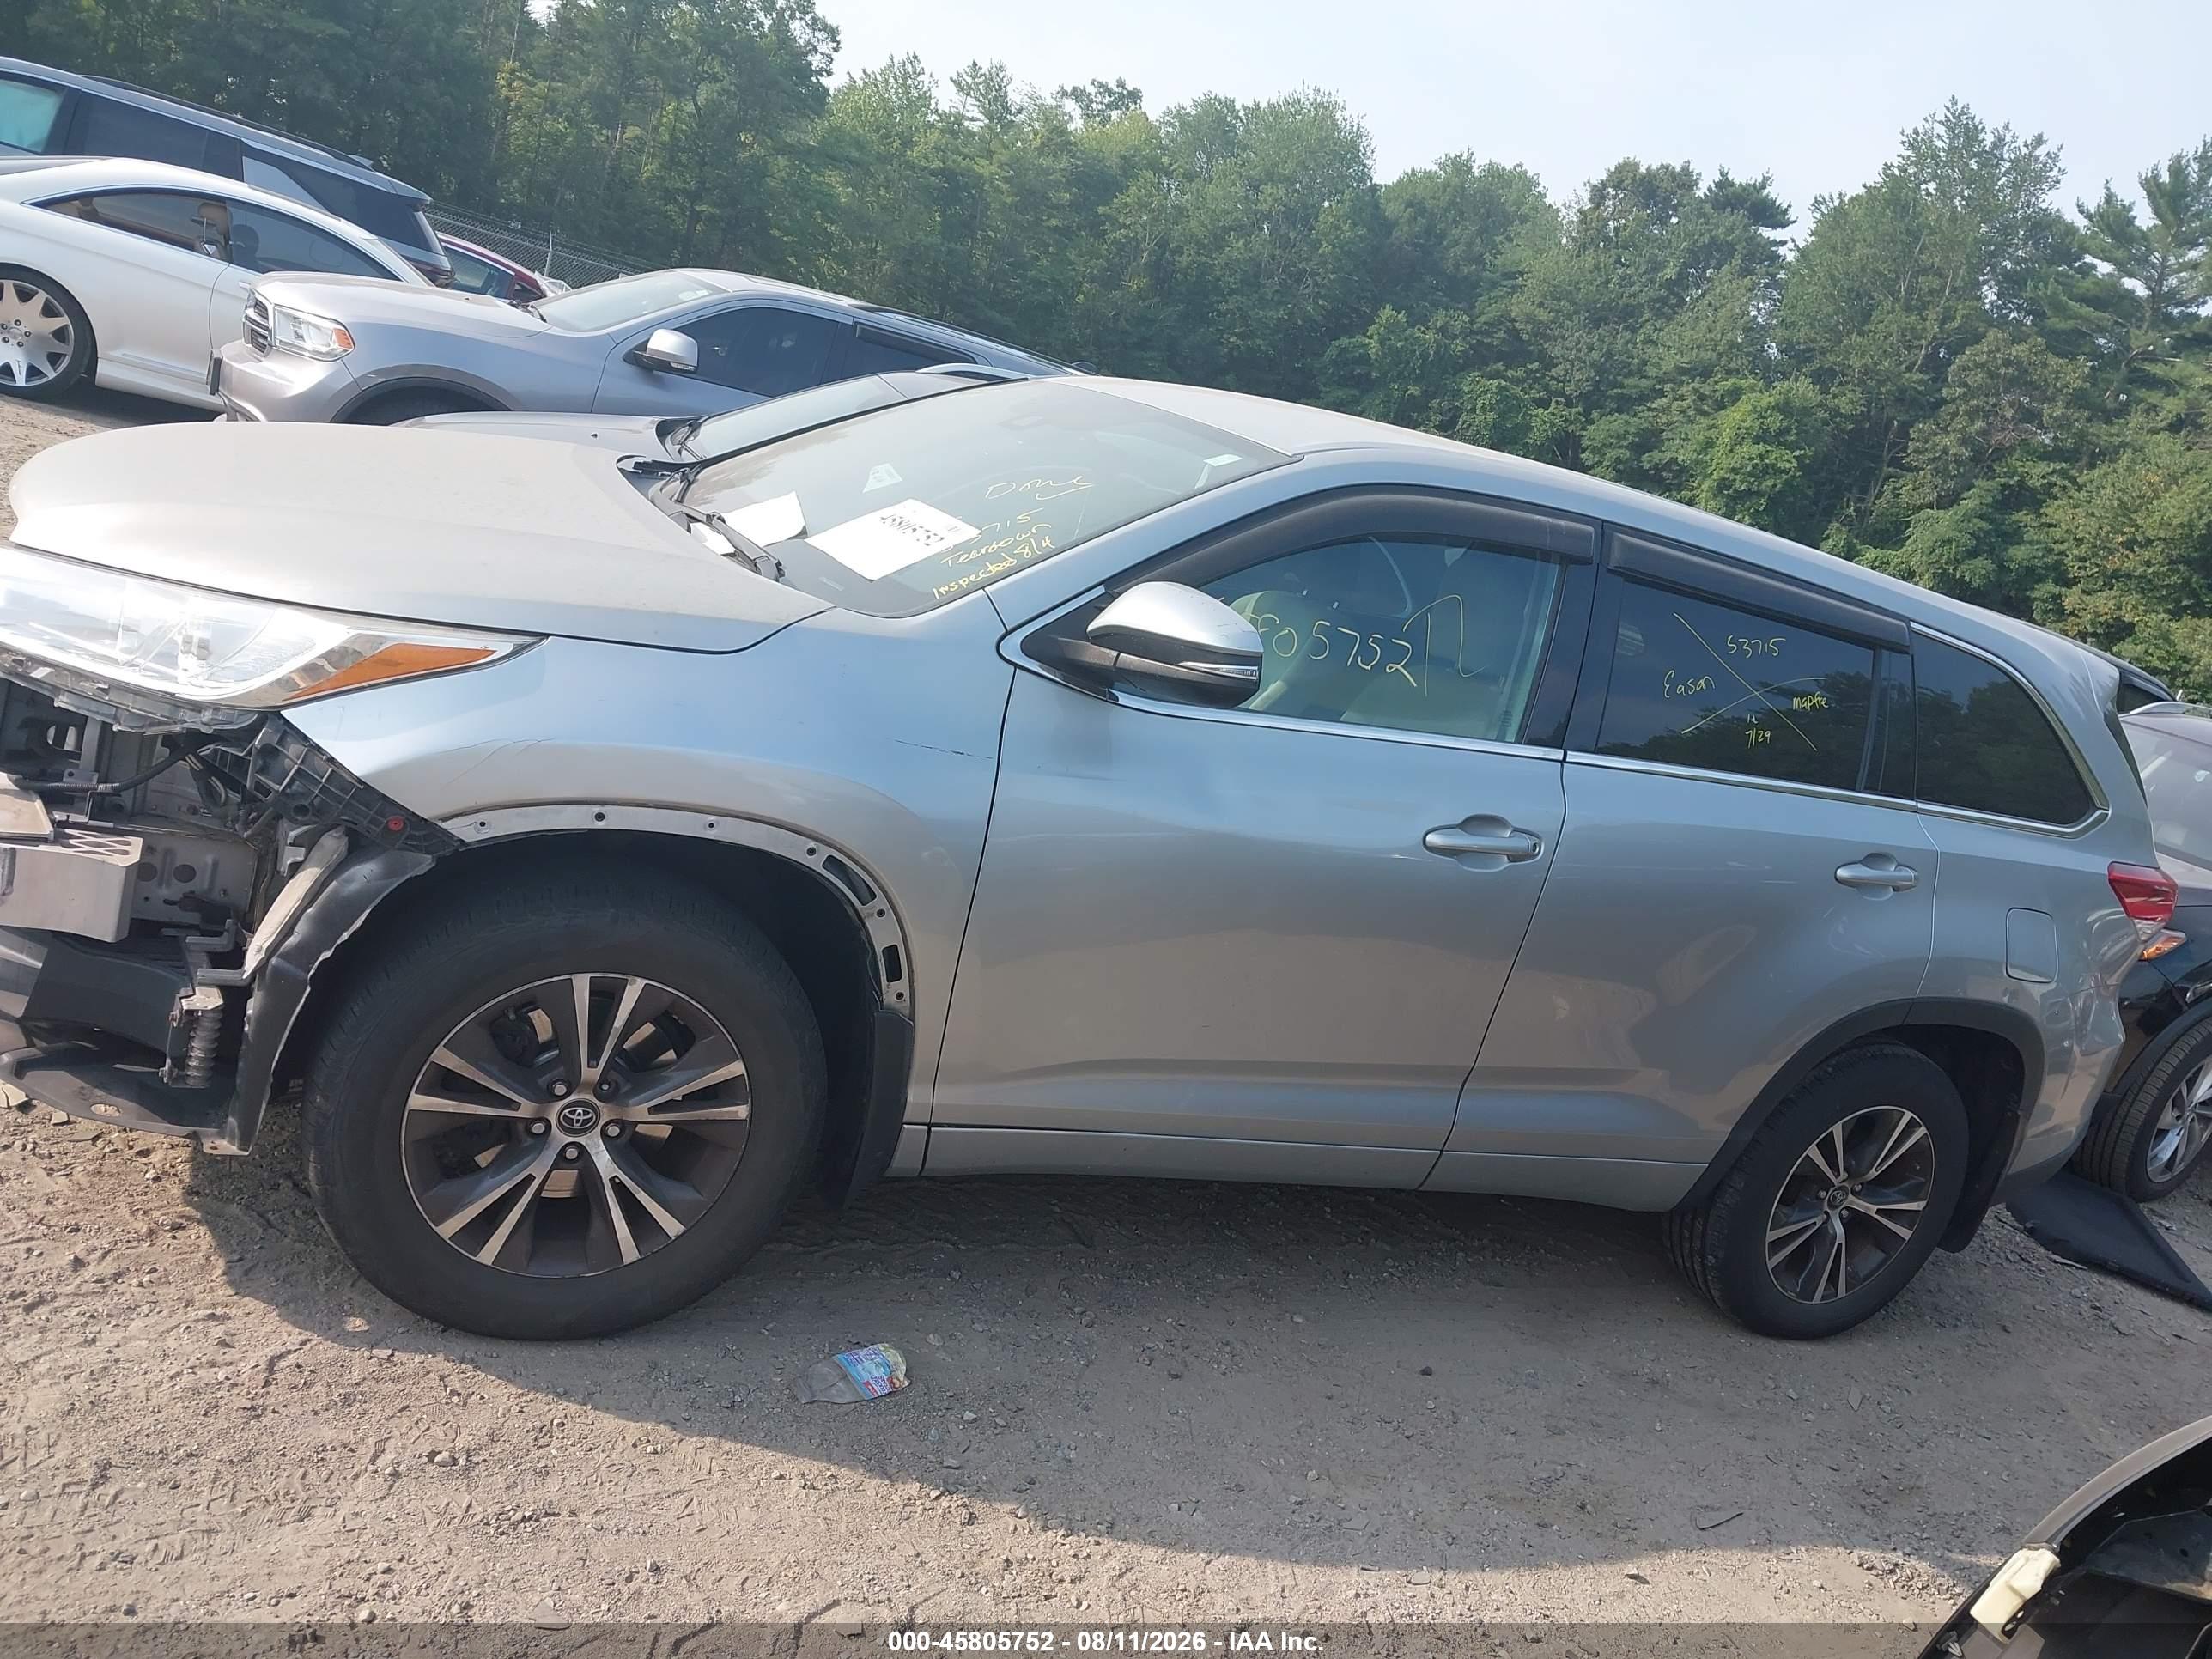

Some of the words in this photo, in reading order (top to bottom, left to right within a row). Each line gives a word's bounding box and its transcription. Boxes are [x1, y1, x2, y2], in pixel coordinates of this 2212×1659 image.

[1013, 536, 1055, 558] 8/4
[1726, 635, 1786, 659] 53715
[1663, 670, 1716, 699] Eason
[1745, 727, 1771, 749] 7/29
